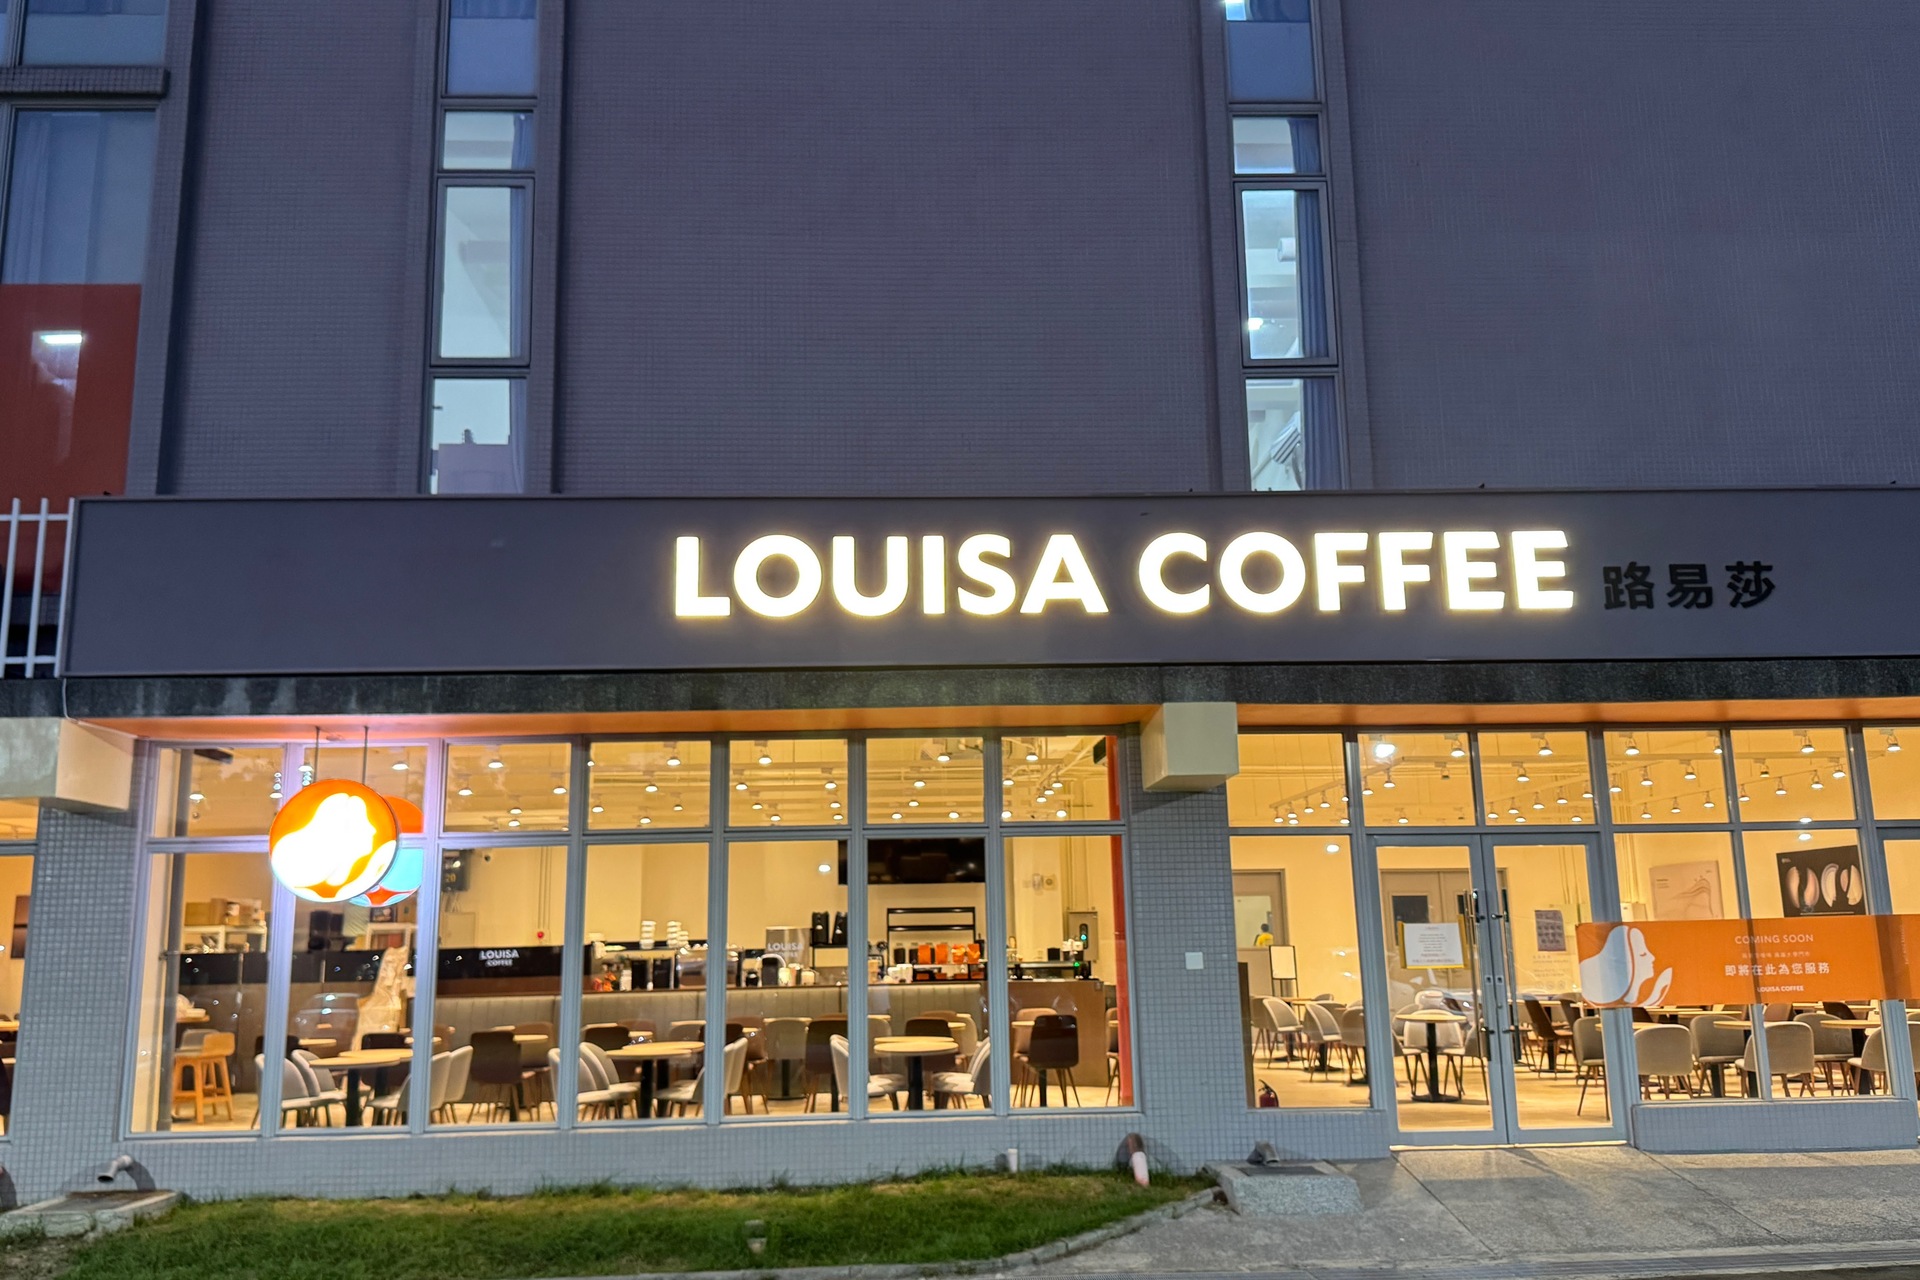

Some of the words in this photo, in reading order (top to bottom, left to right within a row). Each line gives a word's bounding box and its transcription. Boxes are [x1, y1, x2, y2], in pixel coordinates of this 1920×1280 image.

[675, 533, 1109, 617] LOUISA
[1138, 530, 1575, 614] COFFEE
[1602, 560, 1776, 611] 路易莎
[1734, 935, 1780, 944] COMING
[1782, 934, 1814, 943] SOON
[479, 949, 520, 961] LOUISA
[485, 959, 513, 967] COFFEE
[1724, 962, 1830, 976] 即將在此為您服務
